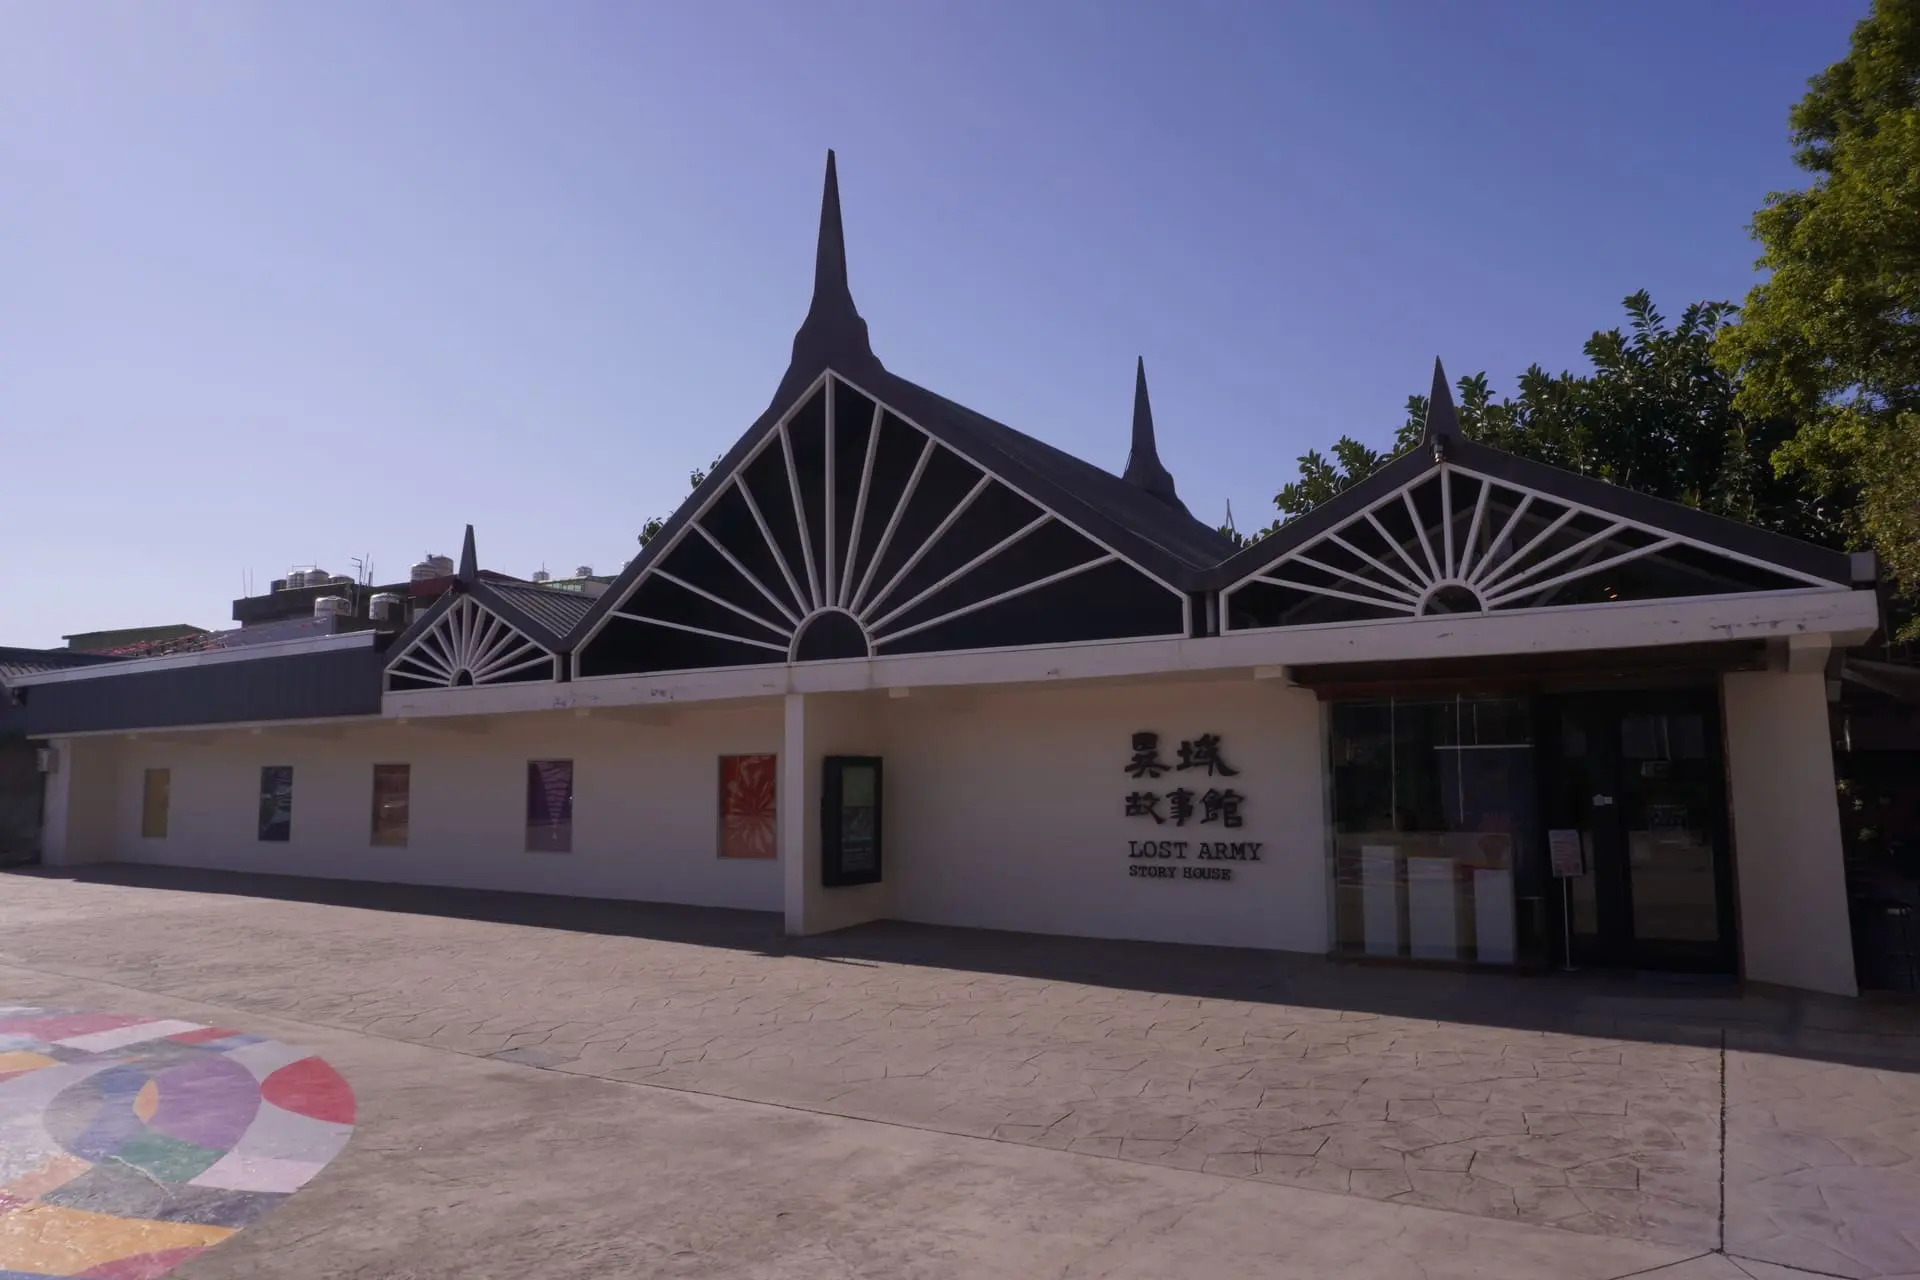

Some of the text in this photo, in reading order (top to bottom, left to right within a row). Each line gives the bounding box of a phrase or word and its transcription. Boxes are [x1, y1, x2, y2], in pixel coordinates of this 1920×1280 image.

[1125, 788, 1245, 828] 故事館
[1128, 841, 1263, 861] LOST ARMY
[1129, 865, 1232, 881] STORY HOUSE
